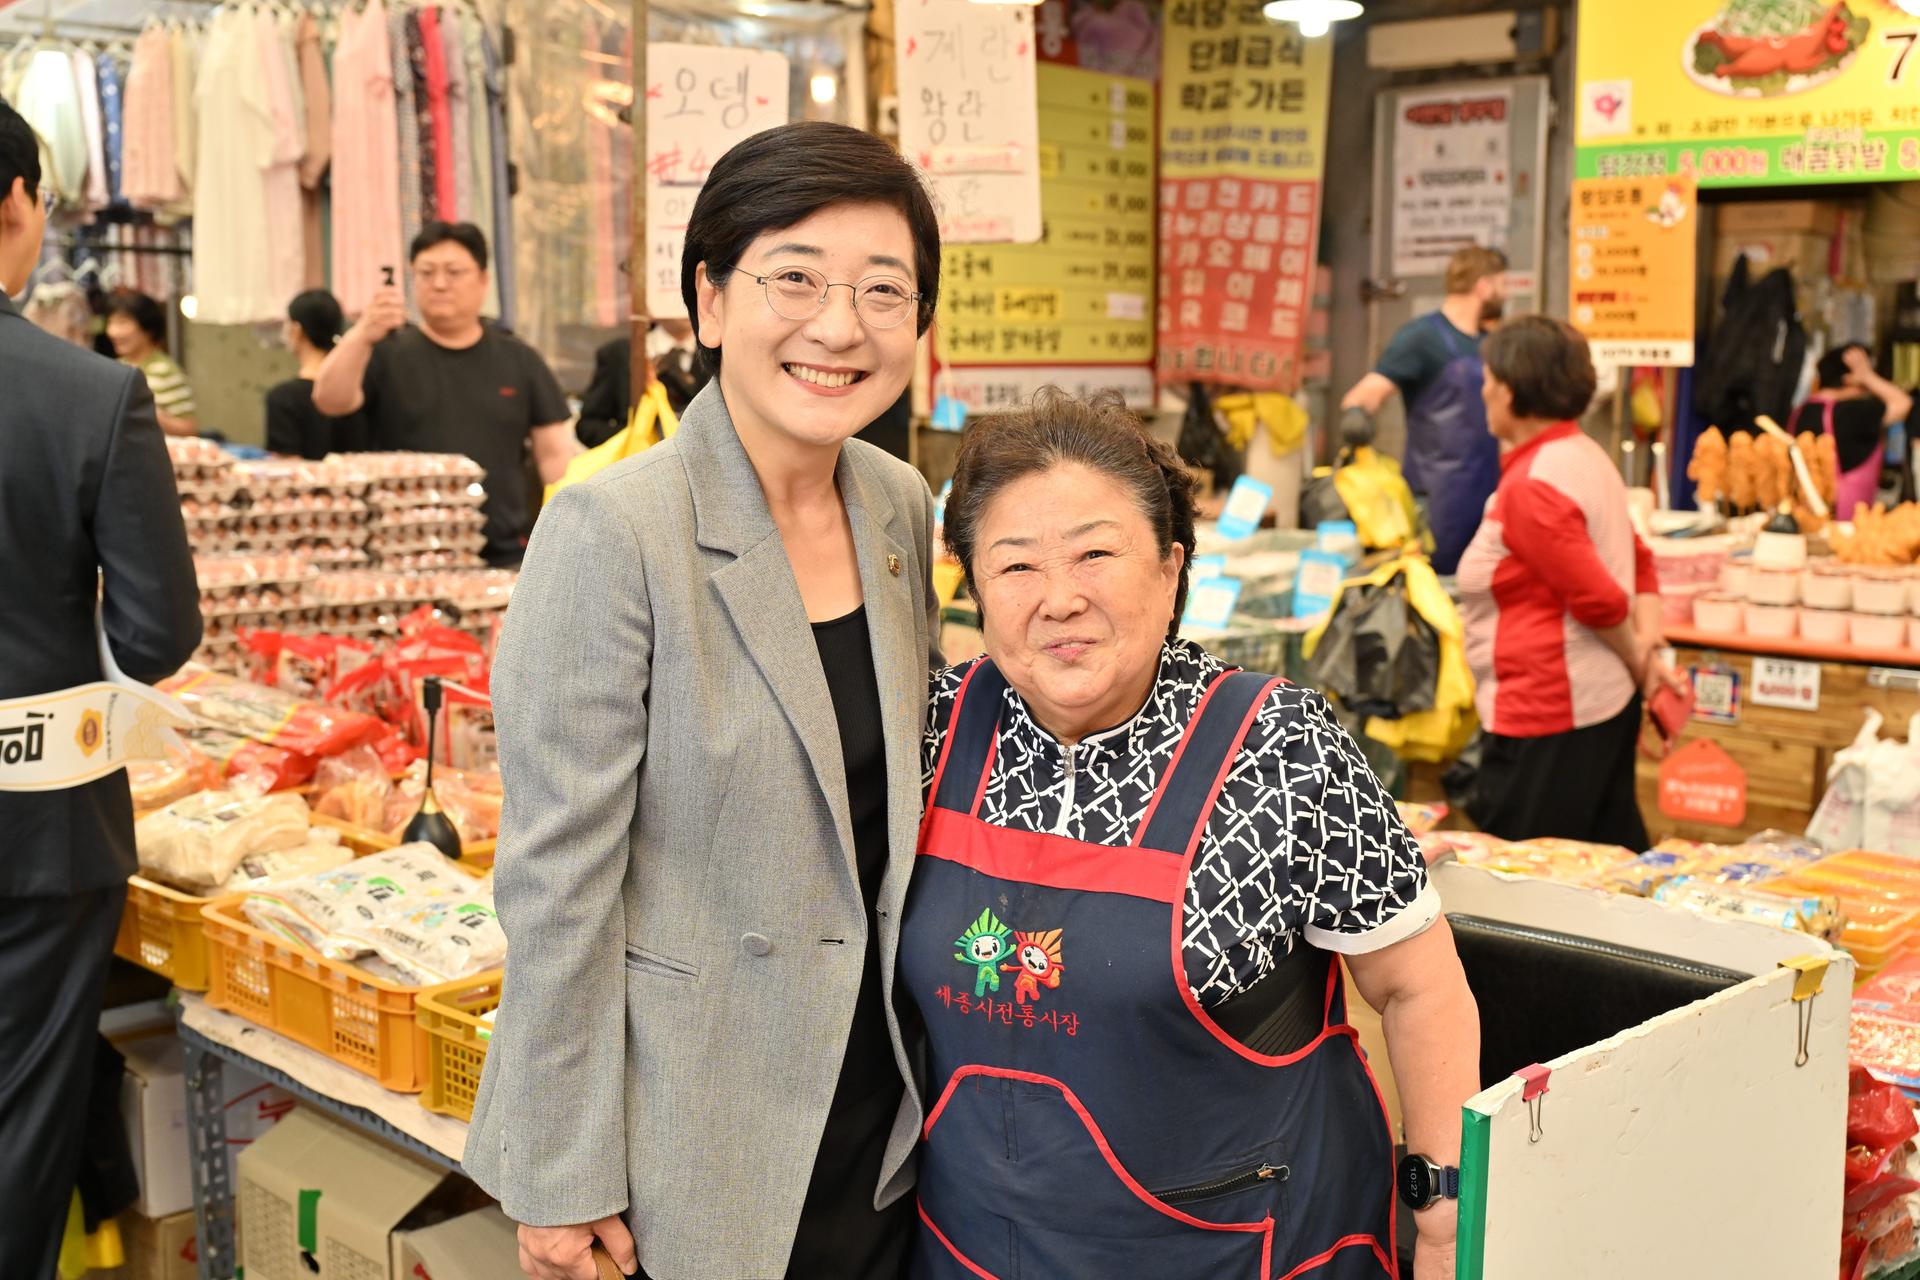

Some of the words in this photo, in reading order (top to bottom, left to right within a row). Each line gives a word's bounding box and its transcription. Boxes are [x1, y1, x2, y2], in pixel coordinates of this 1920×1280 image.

[663, 65, 750, 131] 오뎅
[935, 984, 1081, 1037] 세종시전통시장
[1409, 1166, 1419, 1199] 10:27
